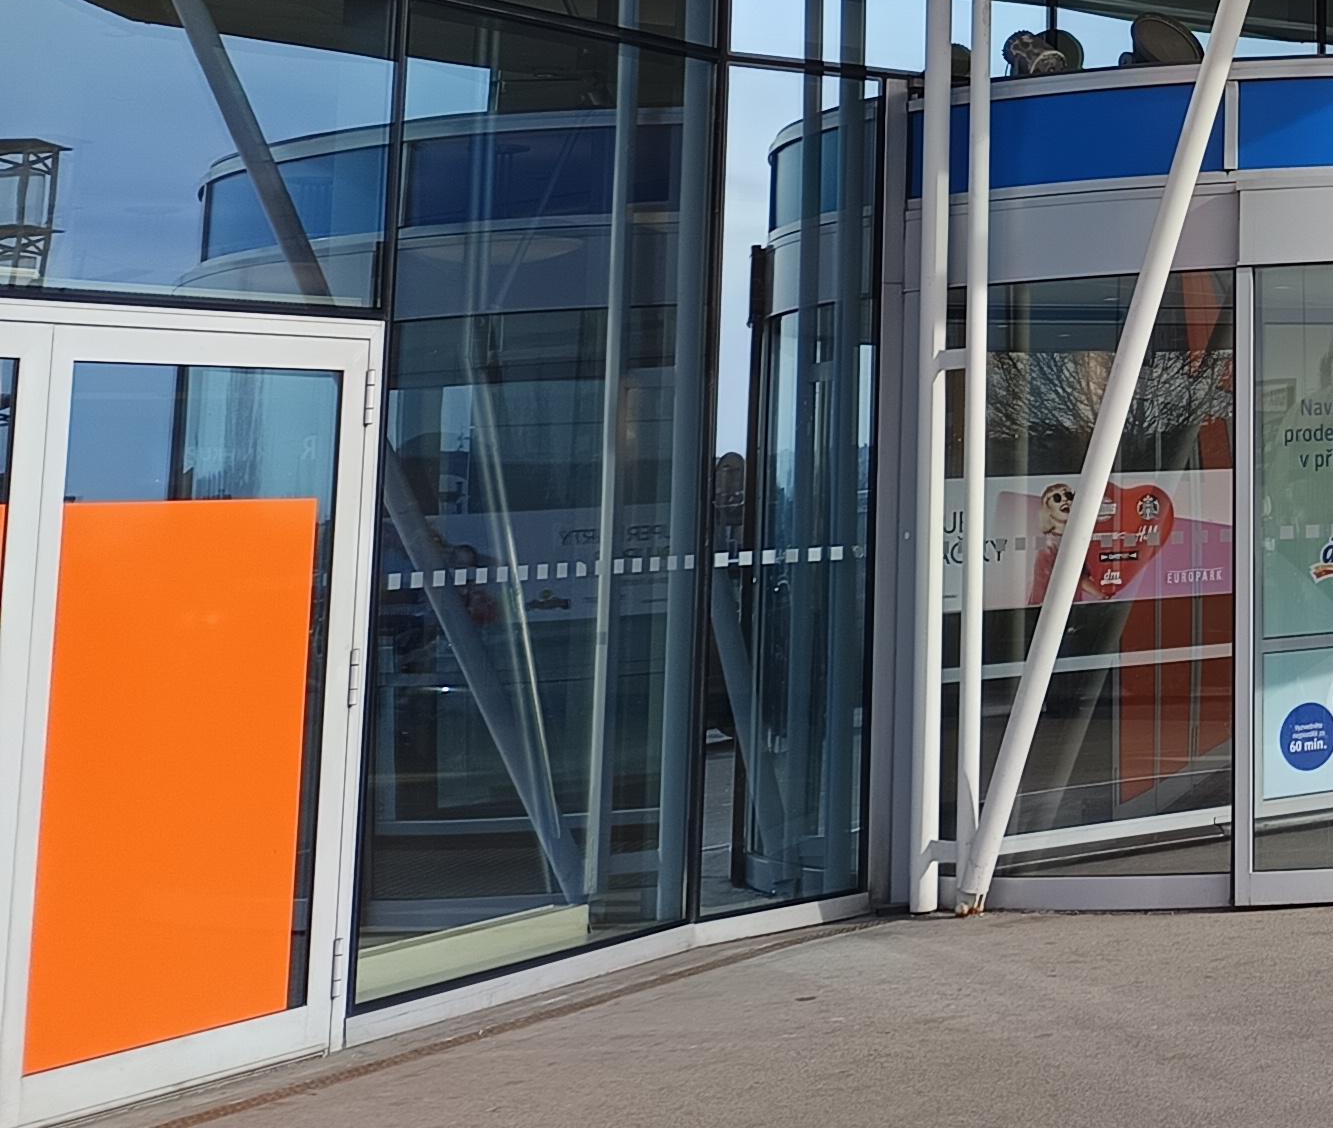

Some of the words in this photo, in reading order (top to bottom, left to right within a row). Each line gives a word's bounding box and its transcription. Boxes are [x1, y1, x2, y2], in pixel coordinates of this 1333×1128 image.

[1299, 454, 1309, 468] v
[1103, 568, 1120, 580] dm
[1166, 569, 1224, 584] EUROPARK
[1289, 740, 1302, 753] 60
[1303, 738, 1328, 752] min.
